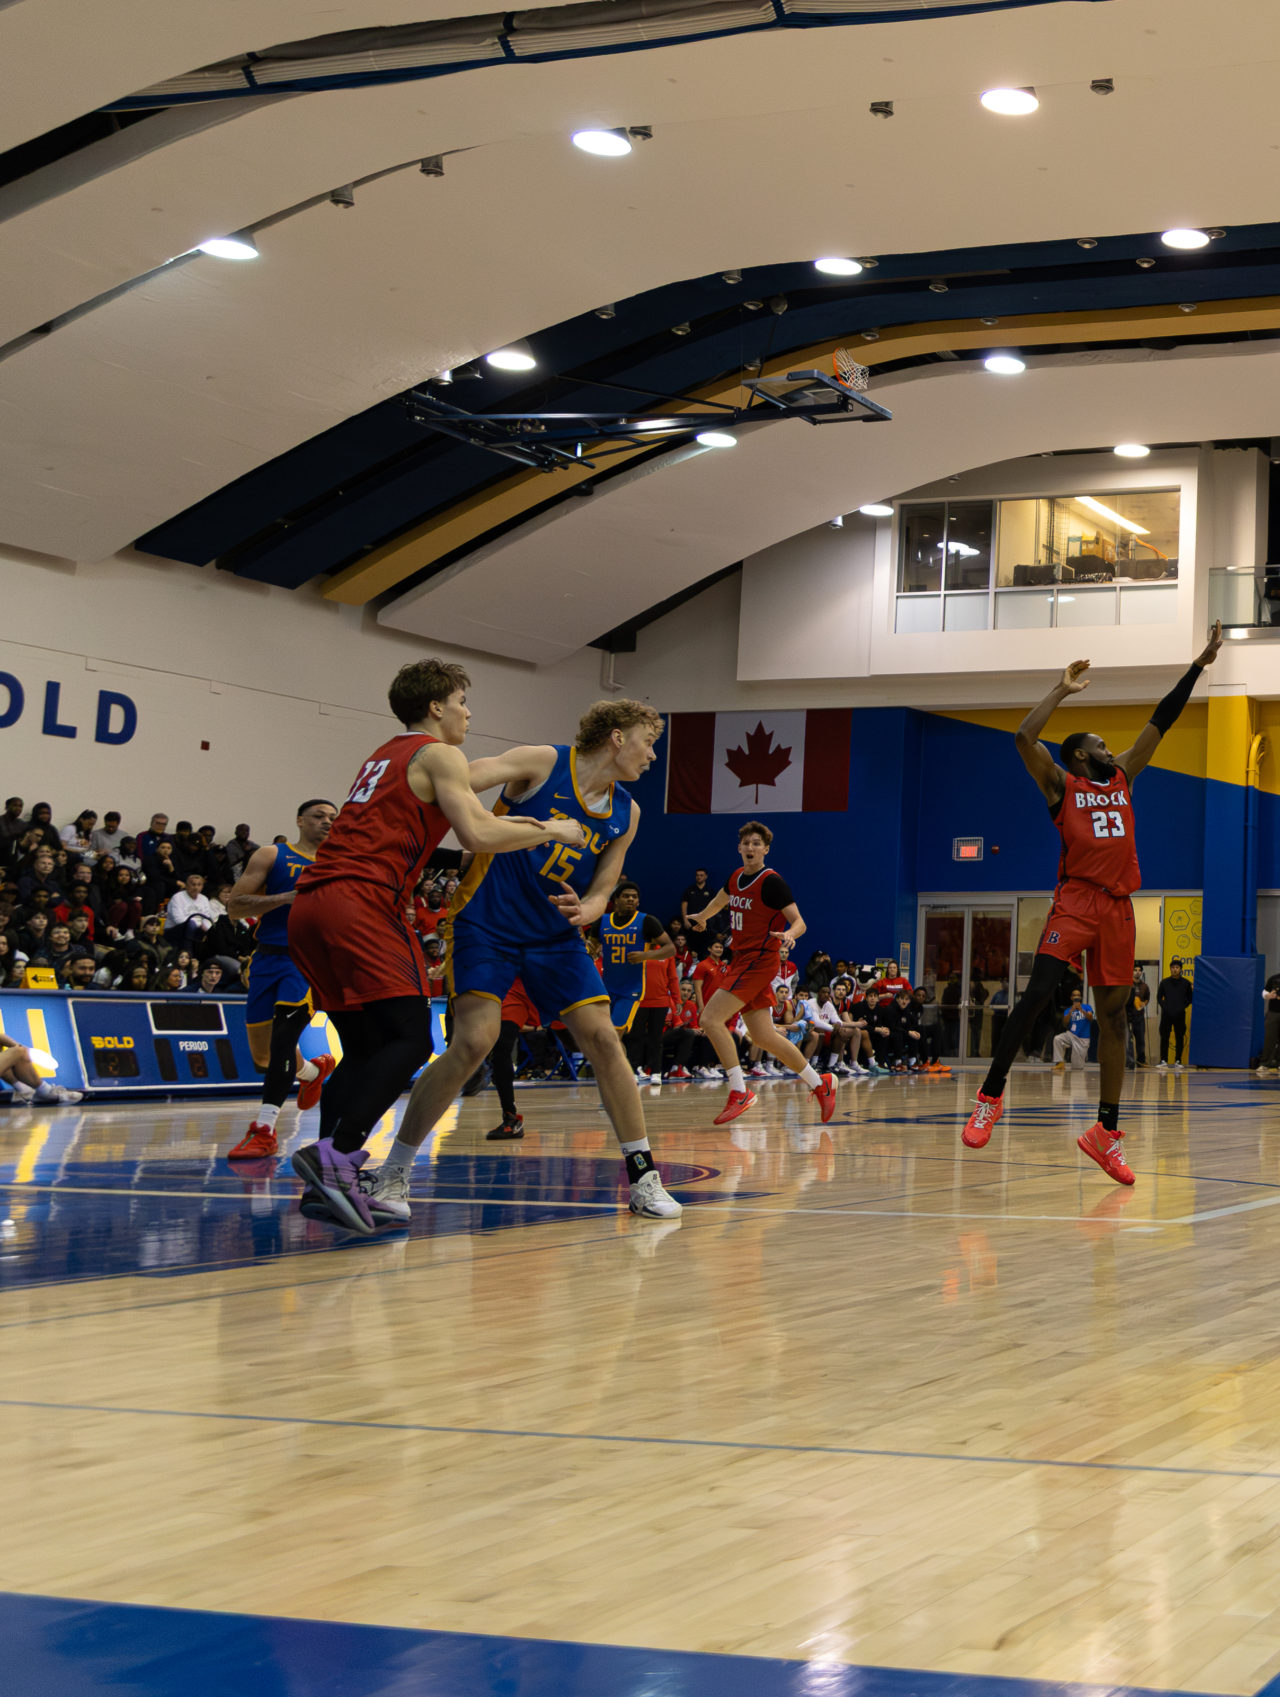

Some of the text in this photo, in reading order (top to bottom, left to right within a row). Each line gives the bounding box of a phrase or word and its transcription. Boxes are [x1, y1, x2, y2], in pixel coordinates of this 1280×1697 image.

[1074, 790, 1128, 808] BROCK
[1091, 810, 1126, 838] 23
[539, 843, 583, 883] 15
[729, 895, 752, 910] ROCK
[604, 933, 637, 945] TMU
[1047, 931, 1060, 944] B
[611, 946, 626, 964] 21
[91, 1036, 135, 1049] BOLD
[179, 1041, 209, 1051] PERIOD
